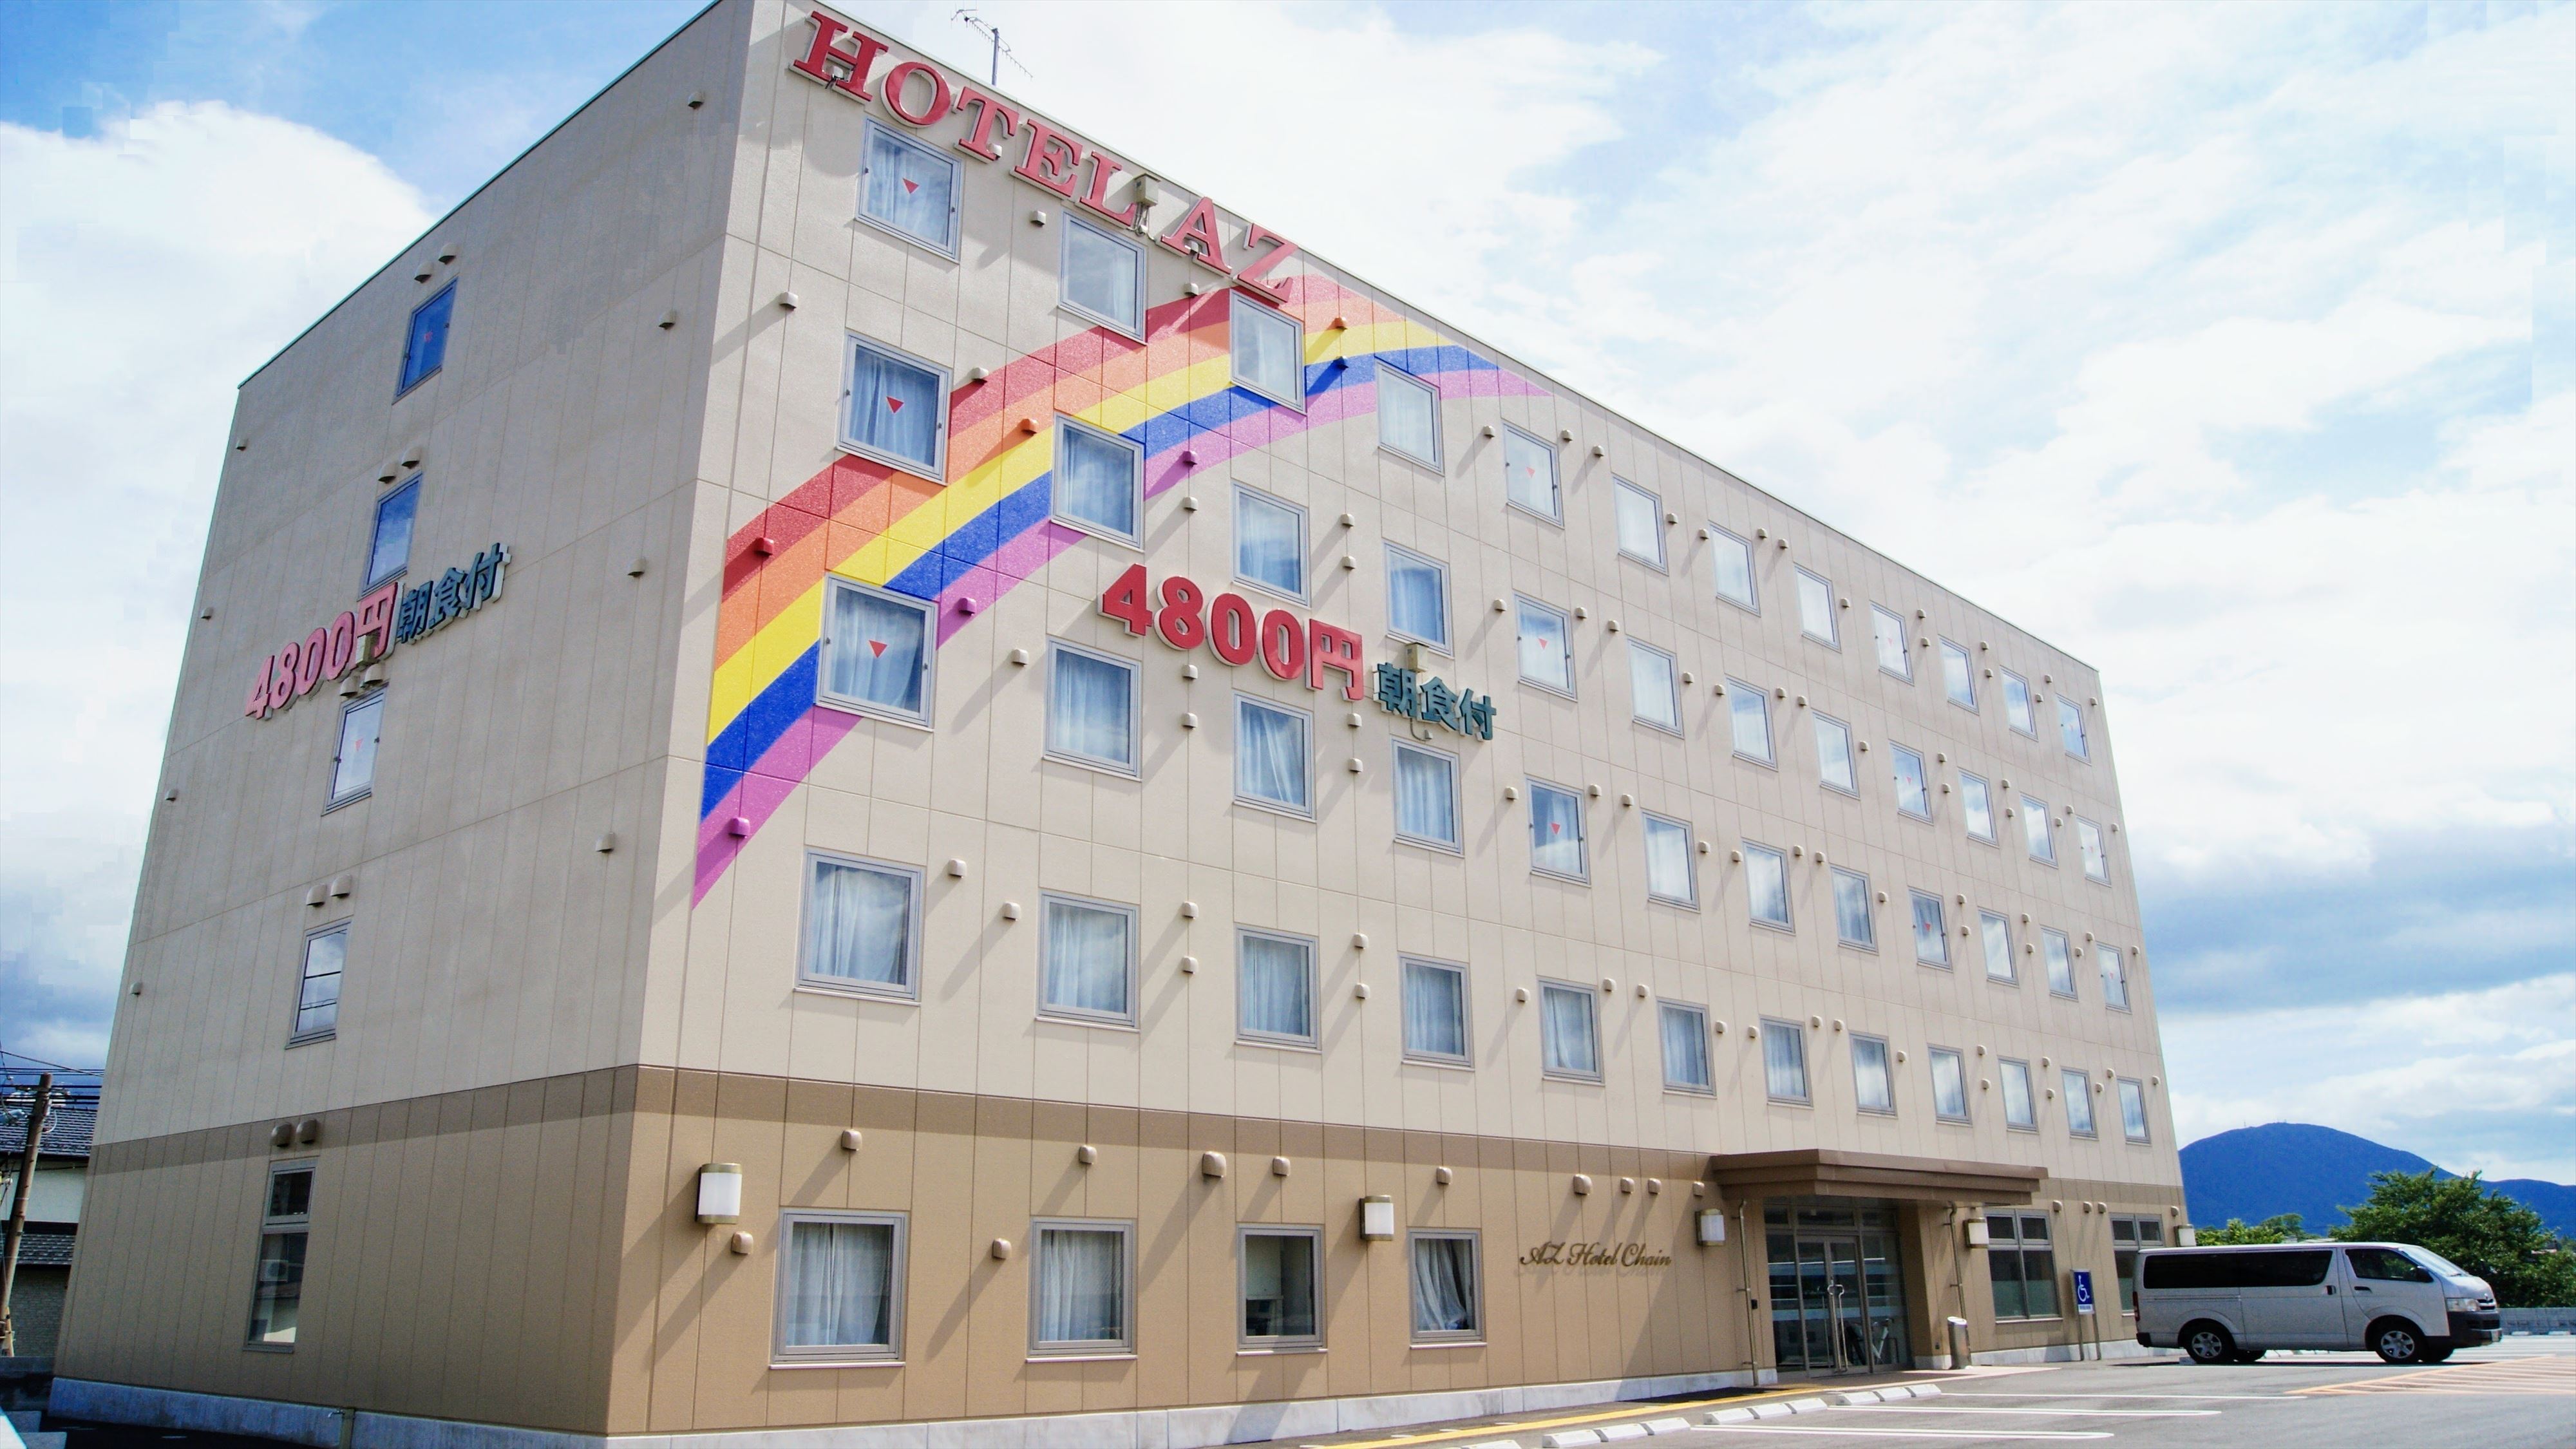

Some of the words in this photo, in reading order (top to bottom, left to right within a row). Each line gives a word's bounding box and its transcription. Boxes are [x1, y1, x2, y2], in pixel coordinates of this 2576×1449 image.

[790, 10, 1138, 229] HOTEL
[1160, 196, 1299, 305] AZ
[245, 582, 402, 720] 4800円
[396, 543, 511, 645] 朝食付
[1098, 563, 1365, 701] 4800円
[1372, 661, 1497, 741] 朝食付
[1520, 1241, 1566, 1266] AZ
[1567, 1242, 1623, 1266] Hotel
[1622, 1242, 1672, 1267] Chain
